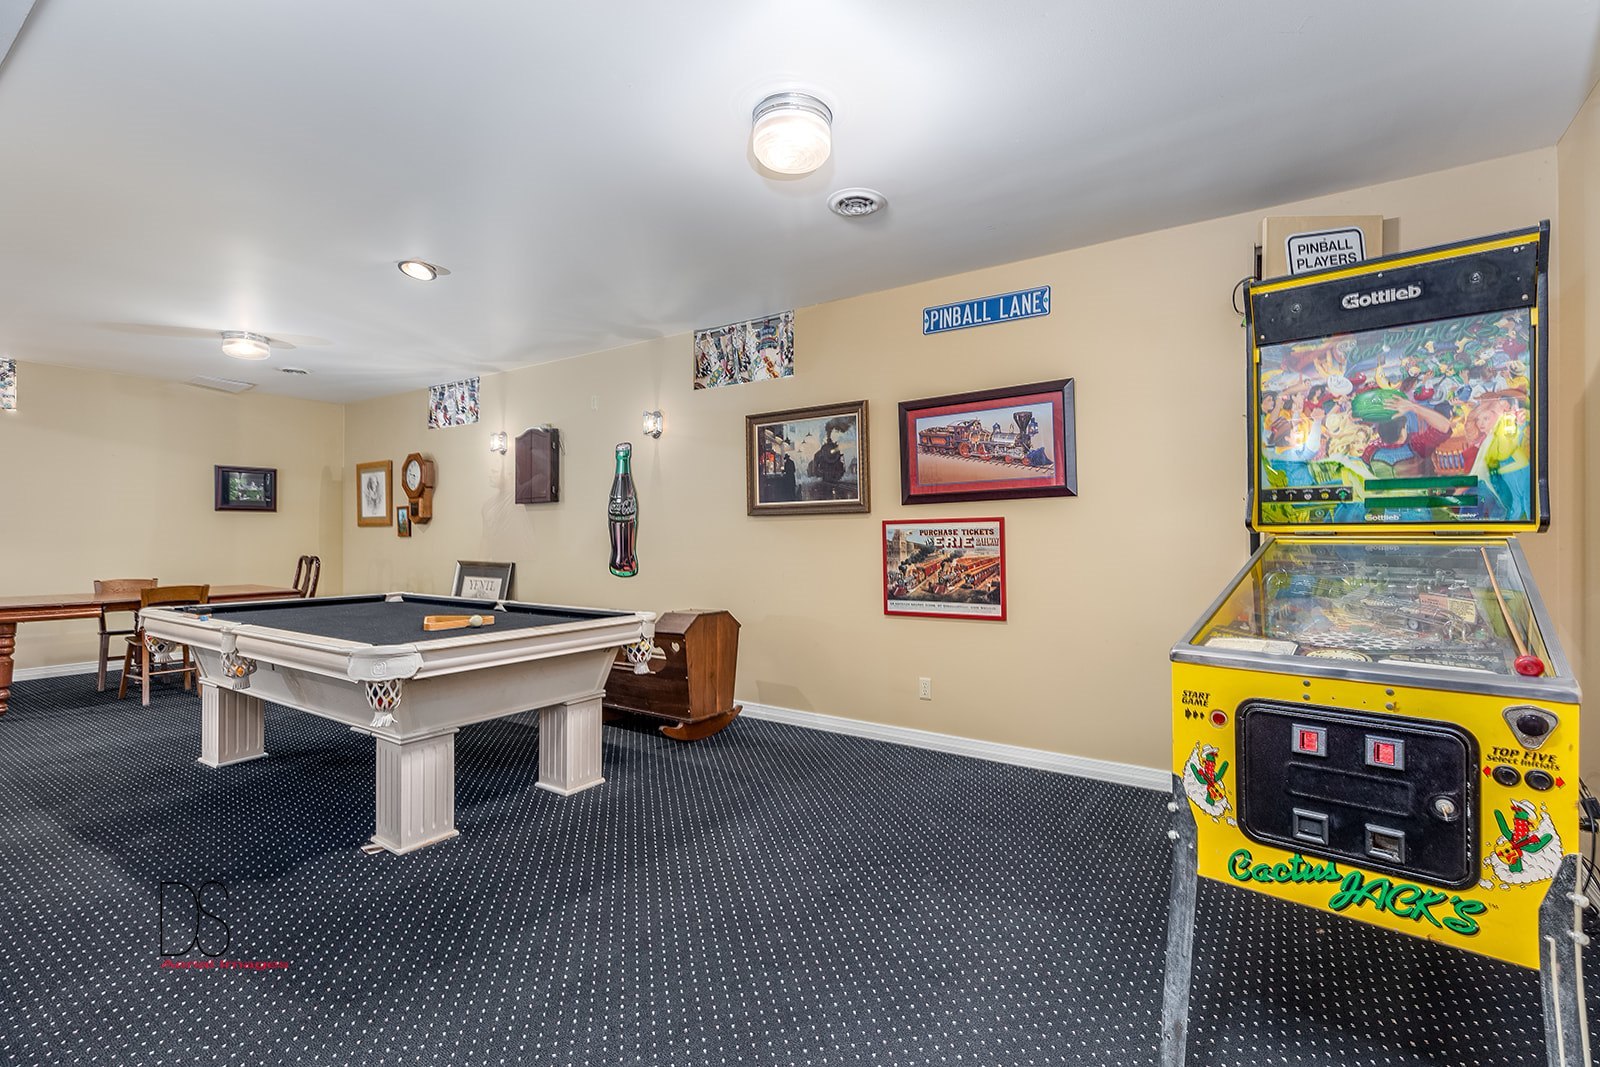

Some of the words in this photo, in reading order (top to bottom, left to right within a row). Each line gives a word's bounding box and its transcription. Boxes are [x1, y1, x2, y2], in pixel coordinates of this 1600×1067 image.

[1297, 238, 1354, 256] PINBALL
[1296, 252, 1358, 270] PLAYERS
[1341, 285, 1423, 310] Gottlieb
[930, 301, 992, 330] PINBALL
[999, 291, 1042, 319] LANE
[1364, 513, 1401, 521] Gottlieb
[919, 528, 958, 536] PURCHASE
[961, 528, 995, 536] TICKETS
[933, 536, 975, 549] ERIE
[1181, 697, 1209, 707] GAME
[1182, 690, 1211, 700] START
[1486, 754, 1519, 765] Select
[1492, 746, 1520, 758] TOP
[1523, 751, 1558, 764] FIVE
[1228, 848, 1343, 883] Cactus
[1328, 870, 1489, 935] JACK'S
